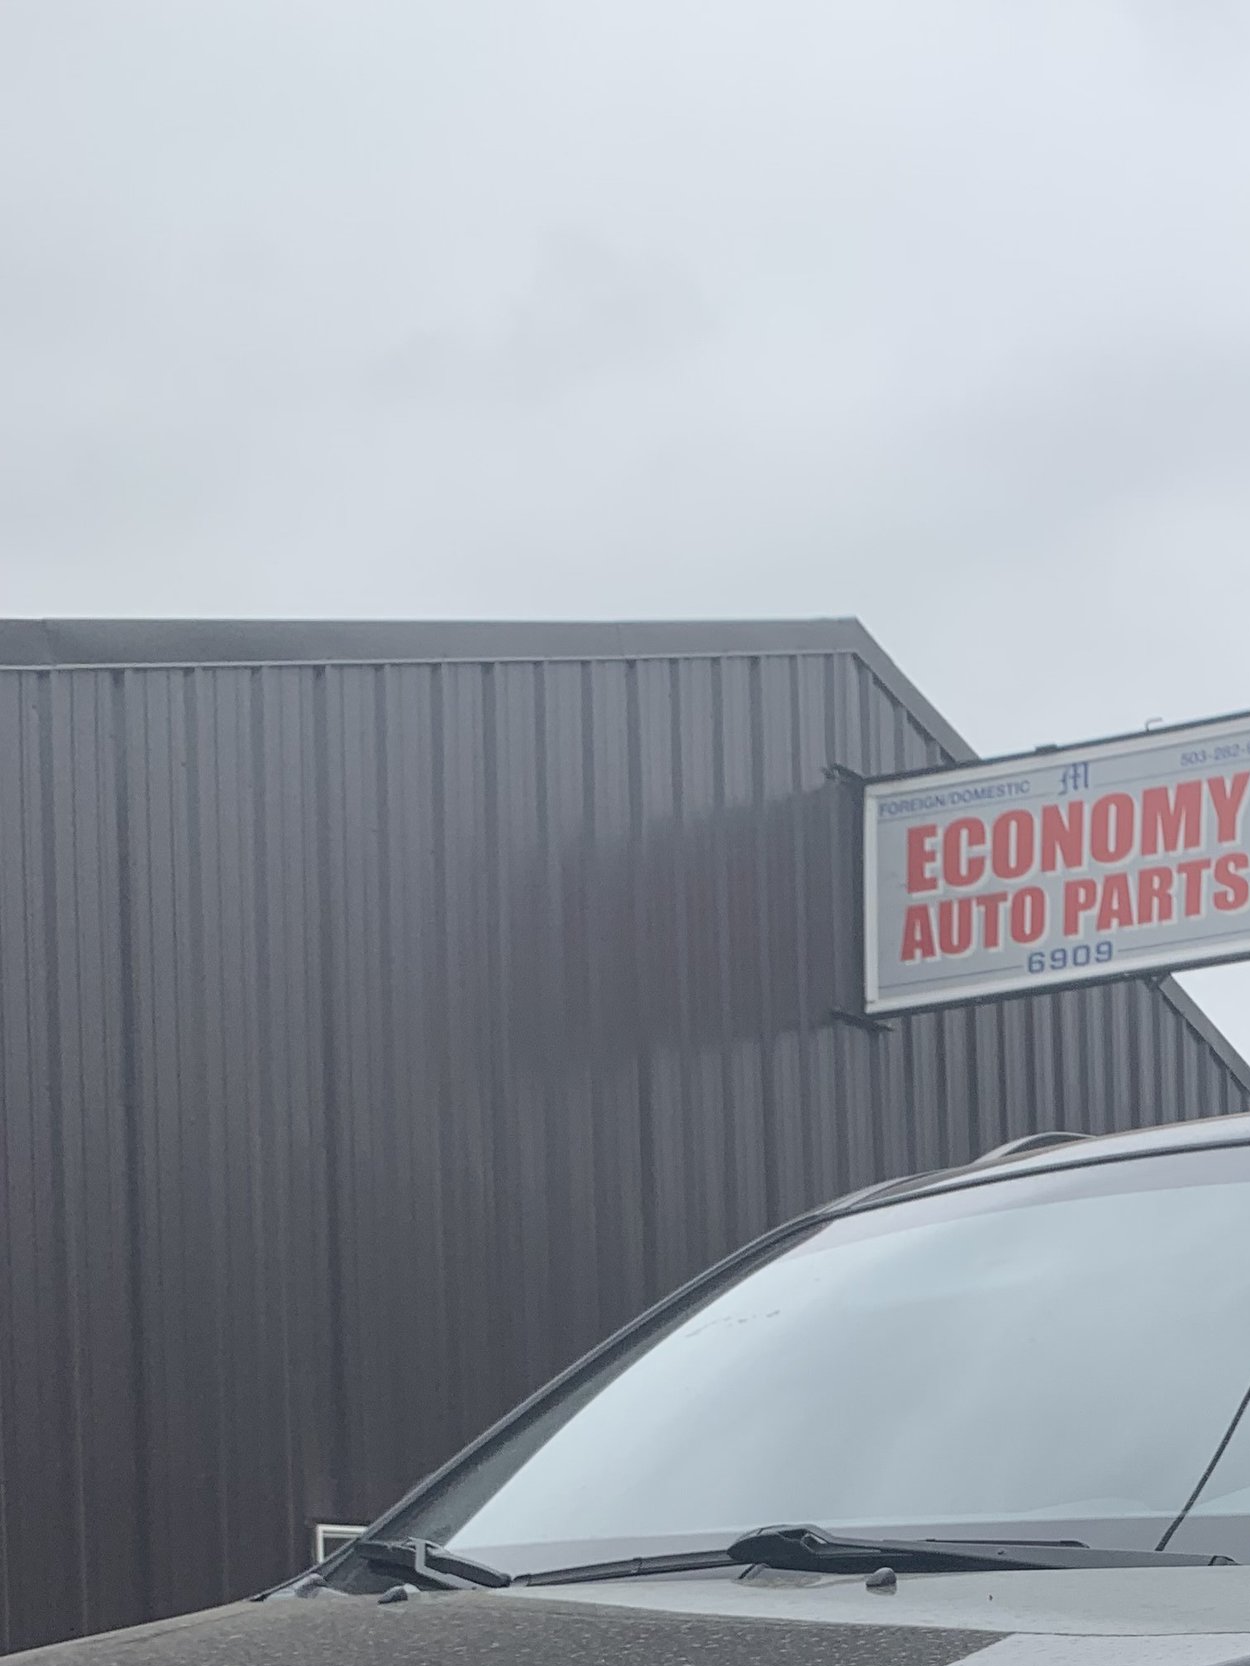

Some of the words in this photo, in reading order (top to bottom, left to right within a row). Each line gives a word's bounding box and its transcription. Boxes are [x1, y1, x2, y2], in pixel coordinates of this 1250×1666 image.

[878, 780, 1031, 817] FOREIGN/DOMESTIC
[900, 886, 1047, 962] AUTO
[1063, 852, 1250, 937] PARTS
[1027, 940, 1114, 975] 6909
